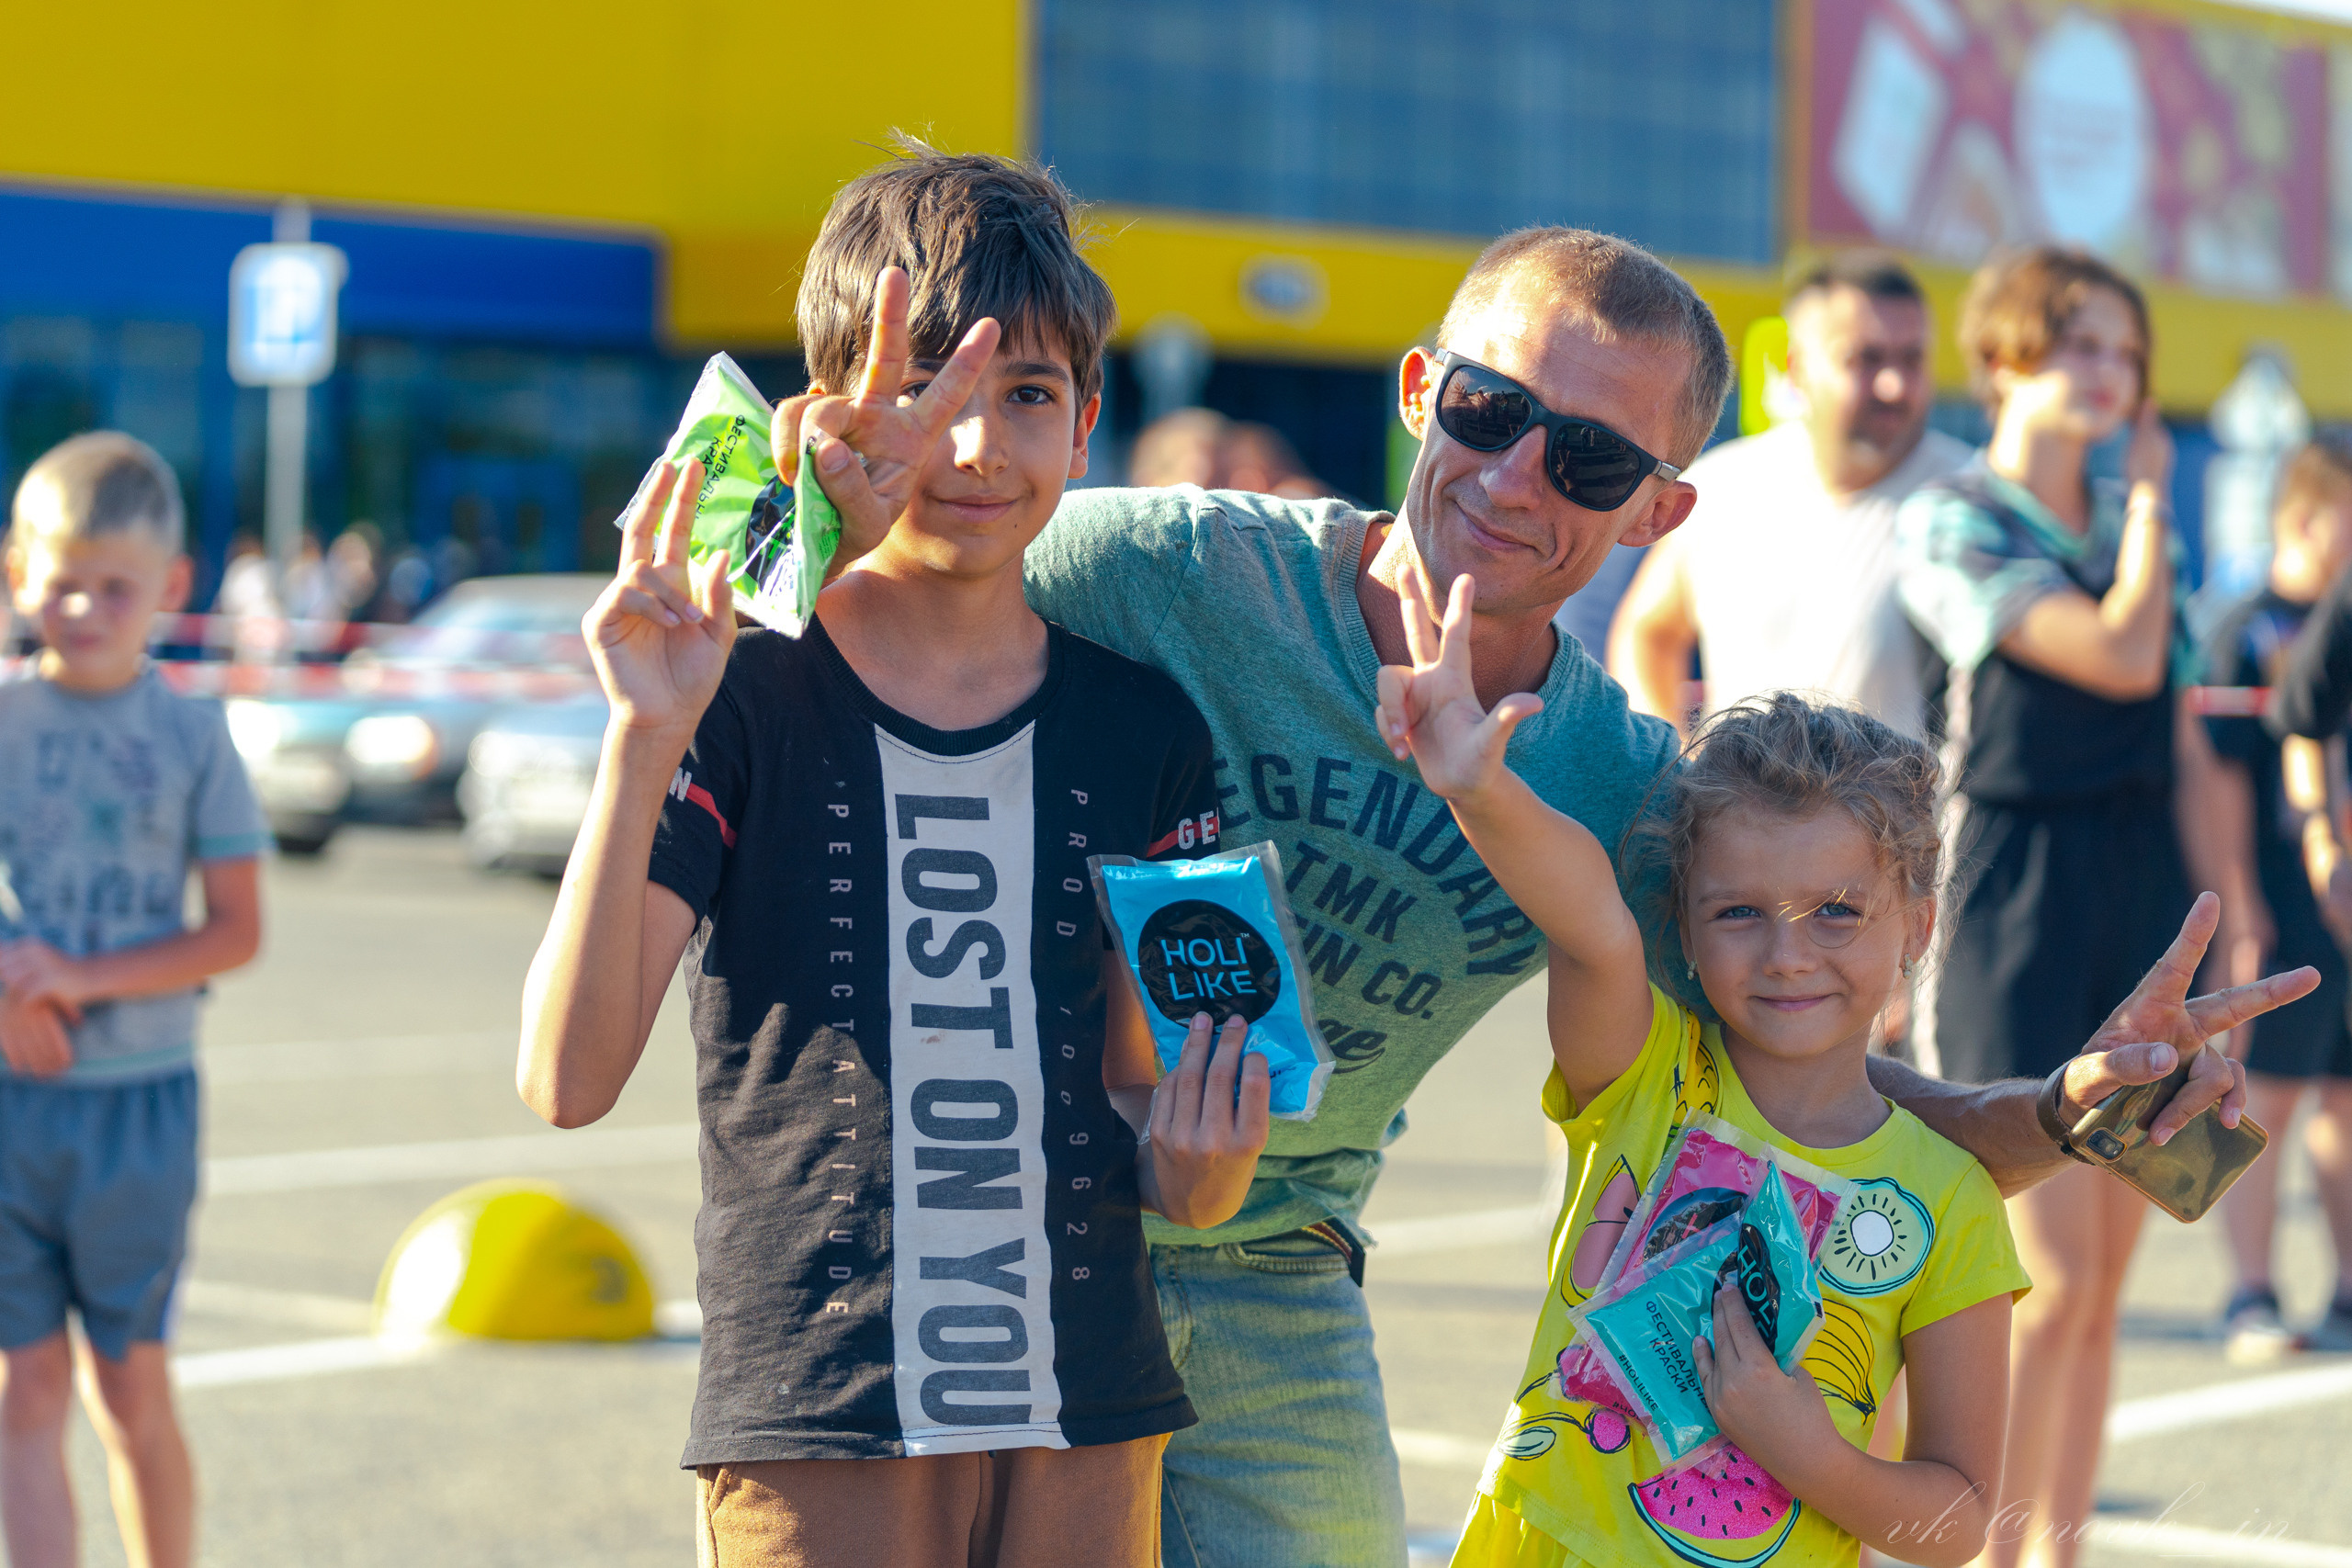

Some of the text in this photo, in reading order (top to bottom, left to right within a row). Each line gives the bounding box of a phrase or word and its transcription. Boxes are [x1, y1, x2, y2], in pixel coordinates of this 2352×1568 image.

[695, 414, 746, 519] ФЕСТИВАЛЬН
[1057, 788, 1089, 937] PROD
[1178, 807, 1220, 850] GE
[1212, 753, 1537, 976] EGENDARY
[1161, 938, 1248, 966] HOLI
[1169, 969, 1258, 1001] LIKE
[826, 804, 856, 1314] PERFECT ATTITUDE
[895, 794, 1034, 1426] LOST ON YOU
[1619, 1354, 1658, 1411] #HOLILIKE
[1645, 1301, 1713, 1416] ФЕСТИВАЛЬНЫ
[1649, 1337, 1689, 1393] КРАСКИ
